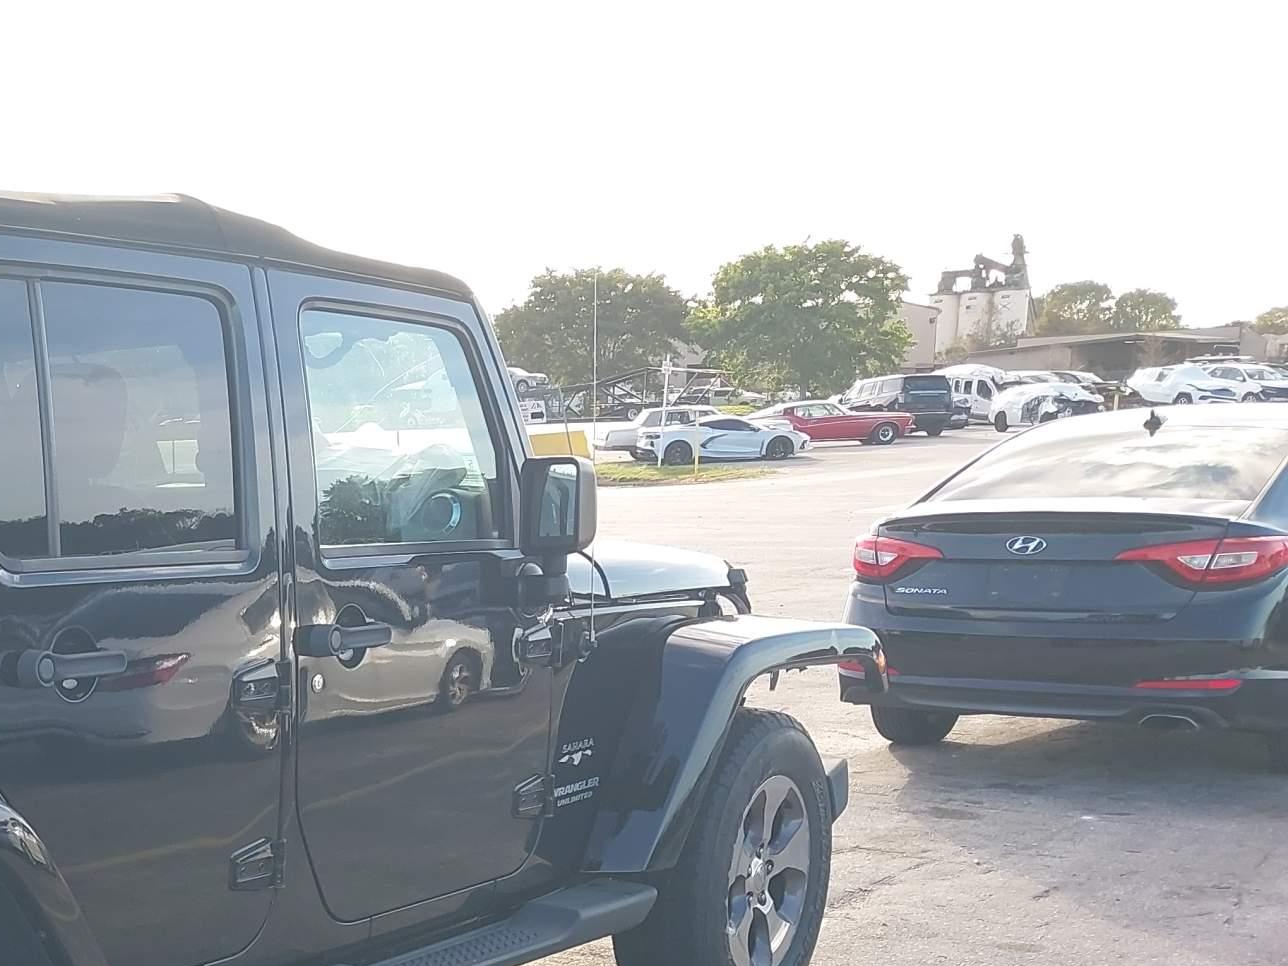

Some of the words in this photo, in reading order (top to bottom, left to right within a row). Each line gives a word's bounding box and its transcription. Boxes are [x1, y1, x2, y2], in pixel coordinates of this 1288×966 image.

[895, 587, 948, 595] SONATA
[562, 738, 594, 753] SAHARA
[557, 791, 593, 807] UNLIMITED
